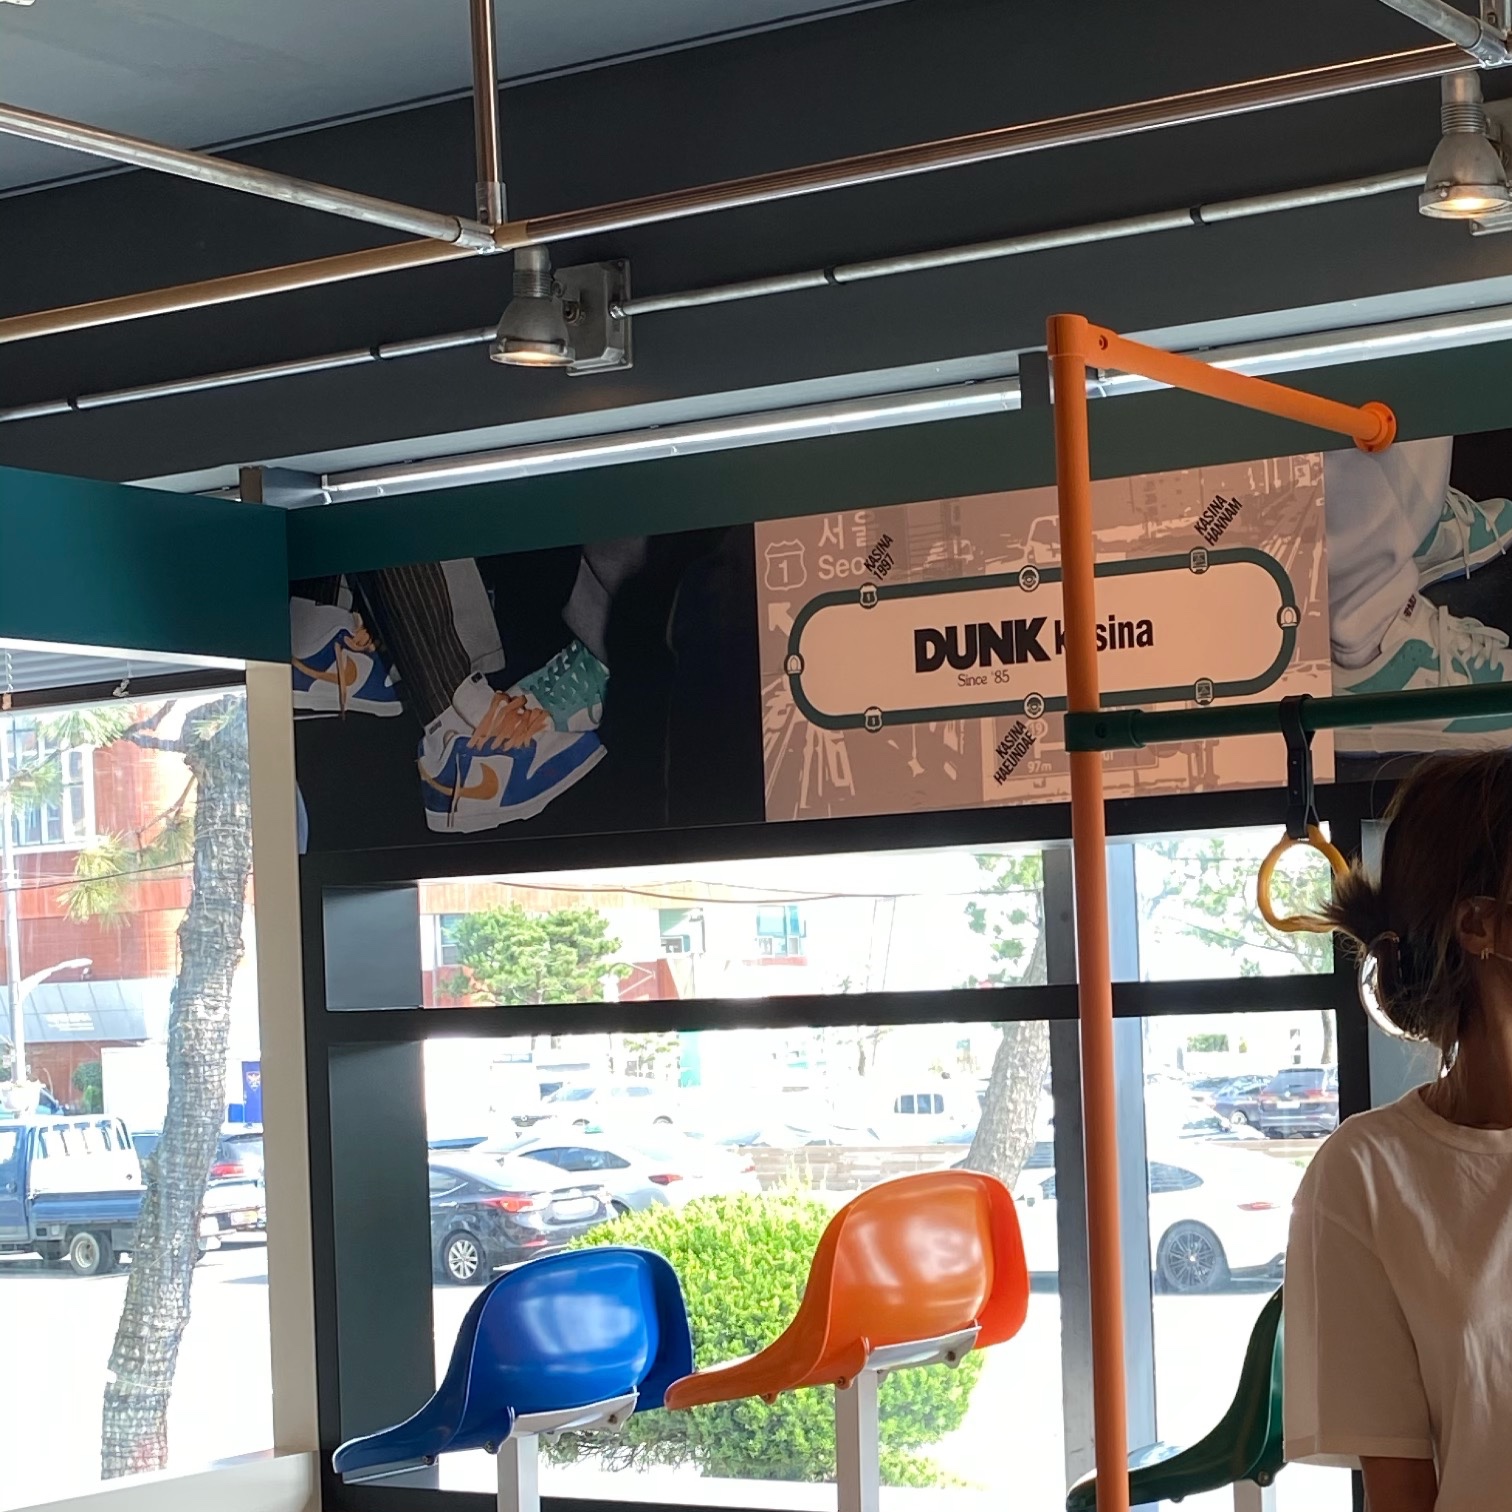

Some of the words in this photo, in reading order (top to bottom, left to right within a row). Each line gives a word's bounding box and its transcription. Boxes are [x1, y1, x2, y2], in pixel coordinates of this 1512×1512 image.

[1194, 494, 1228, 536] KASINA
[1204, 497, 1243, 547] HANNAM
[818, 554, 866, 580] Seo
[863, 533, 894, 572] KASINA
[873, 552, 895, 581] 1997
[914, 616, 1052, 673] DUNK
[1055, 614, 1154, 655] ksina
[957, 672, 988, 687] Since
[993, 729, 1037, 786] HAEUNDAE
[995, 719, 1028, 760] KASINA
